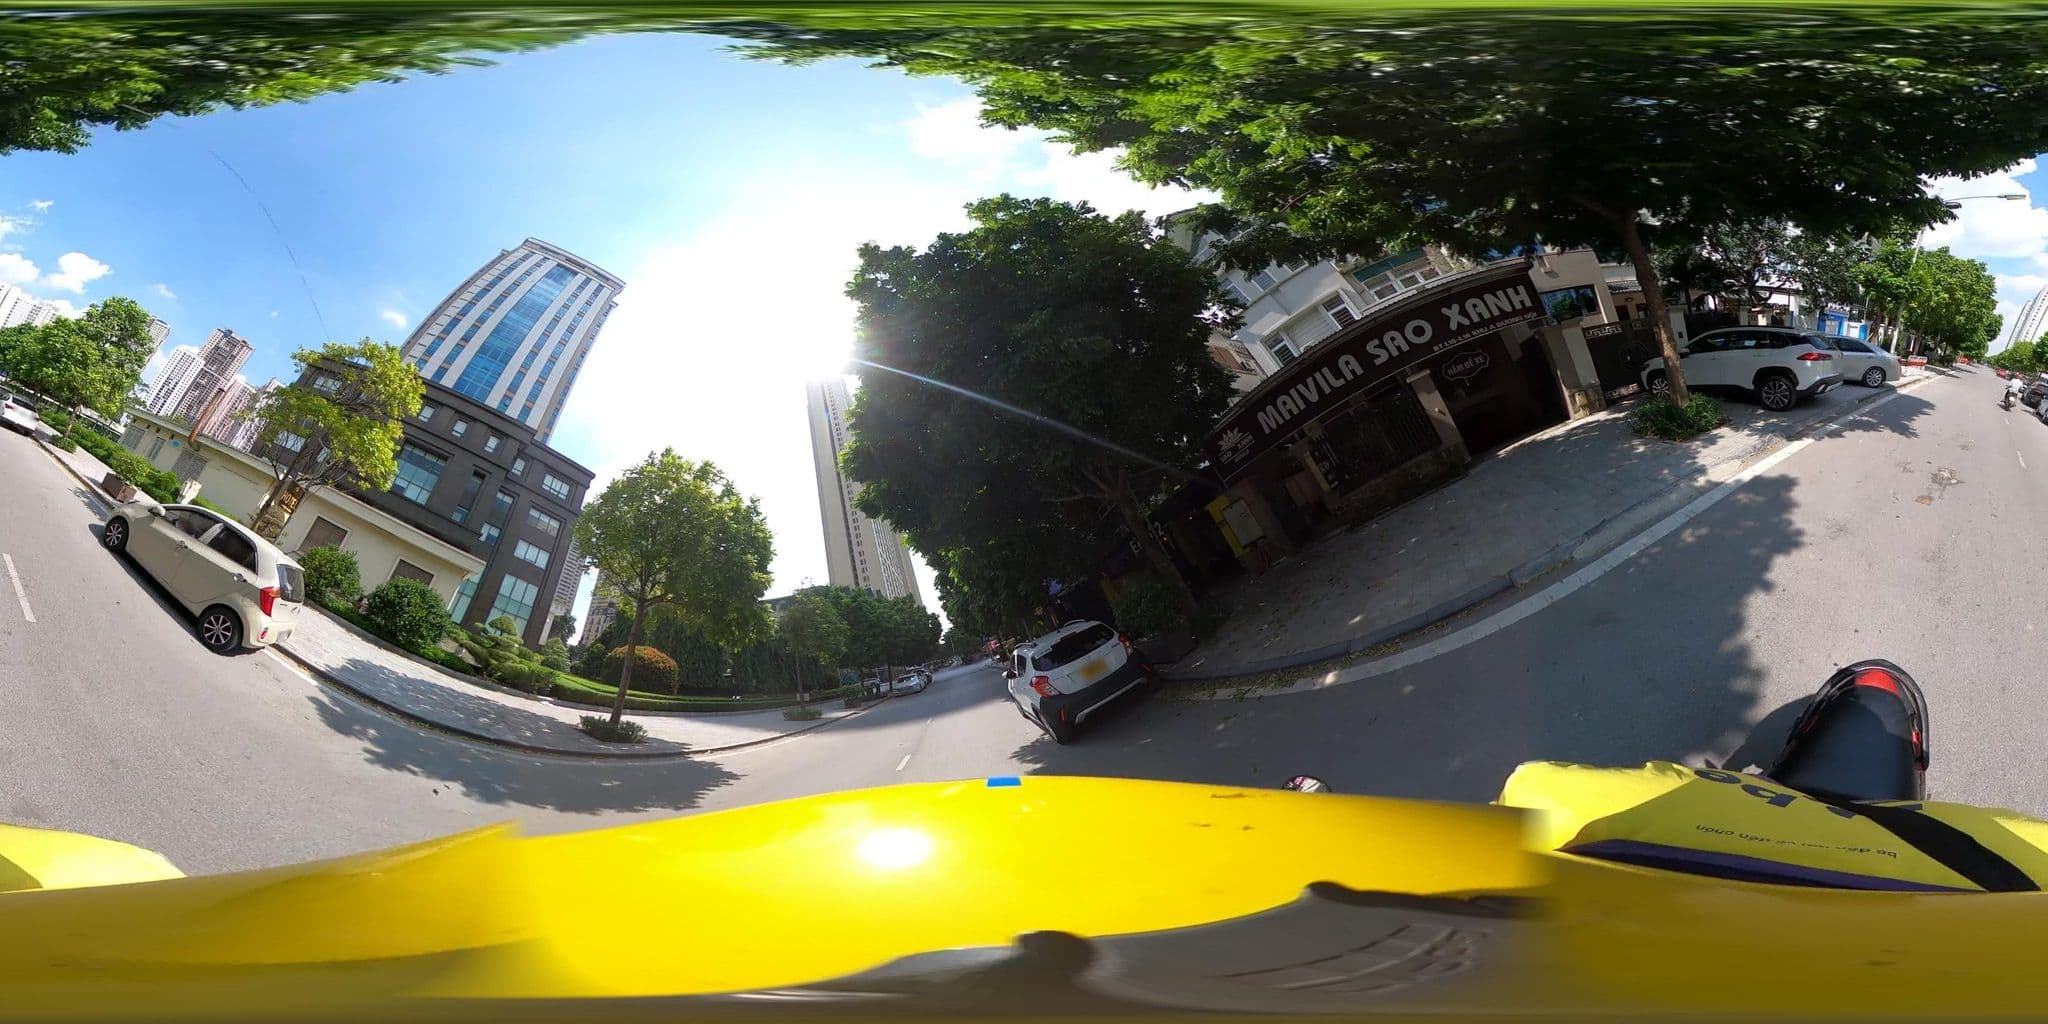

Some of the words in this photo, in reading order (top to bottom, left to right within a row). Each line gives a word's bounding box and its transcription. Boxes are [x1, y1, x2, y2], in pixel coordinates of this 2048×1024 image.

[1257, 354, 1365, 436] MAIVILA
[1366, 319, 1433, 366] SAO
[1441, 284, 1533, 331] XANH
